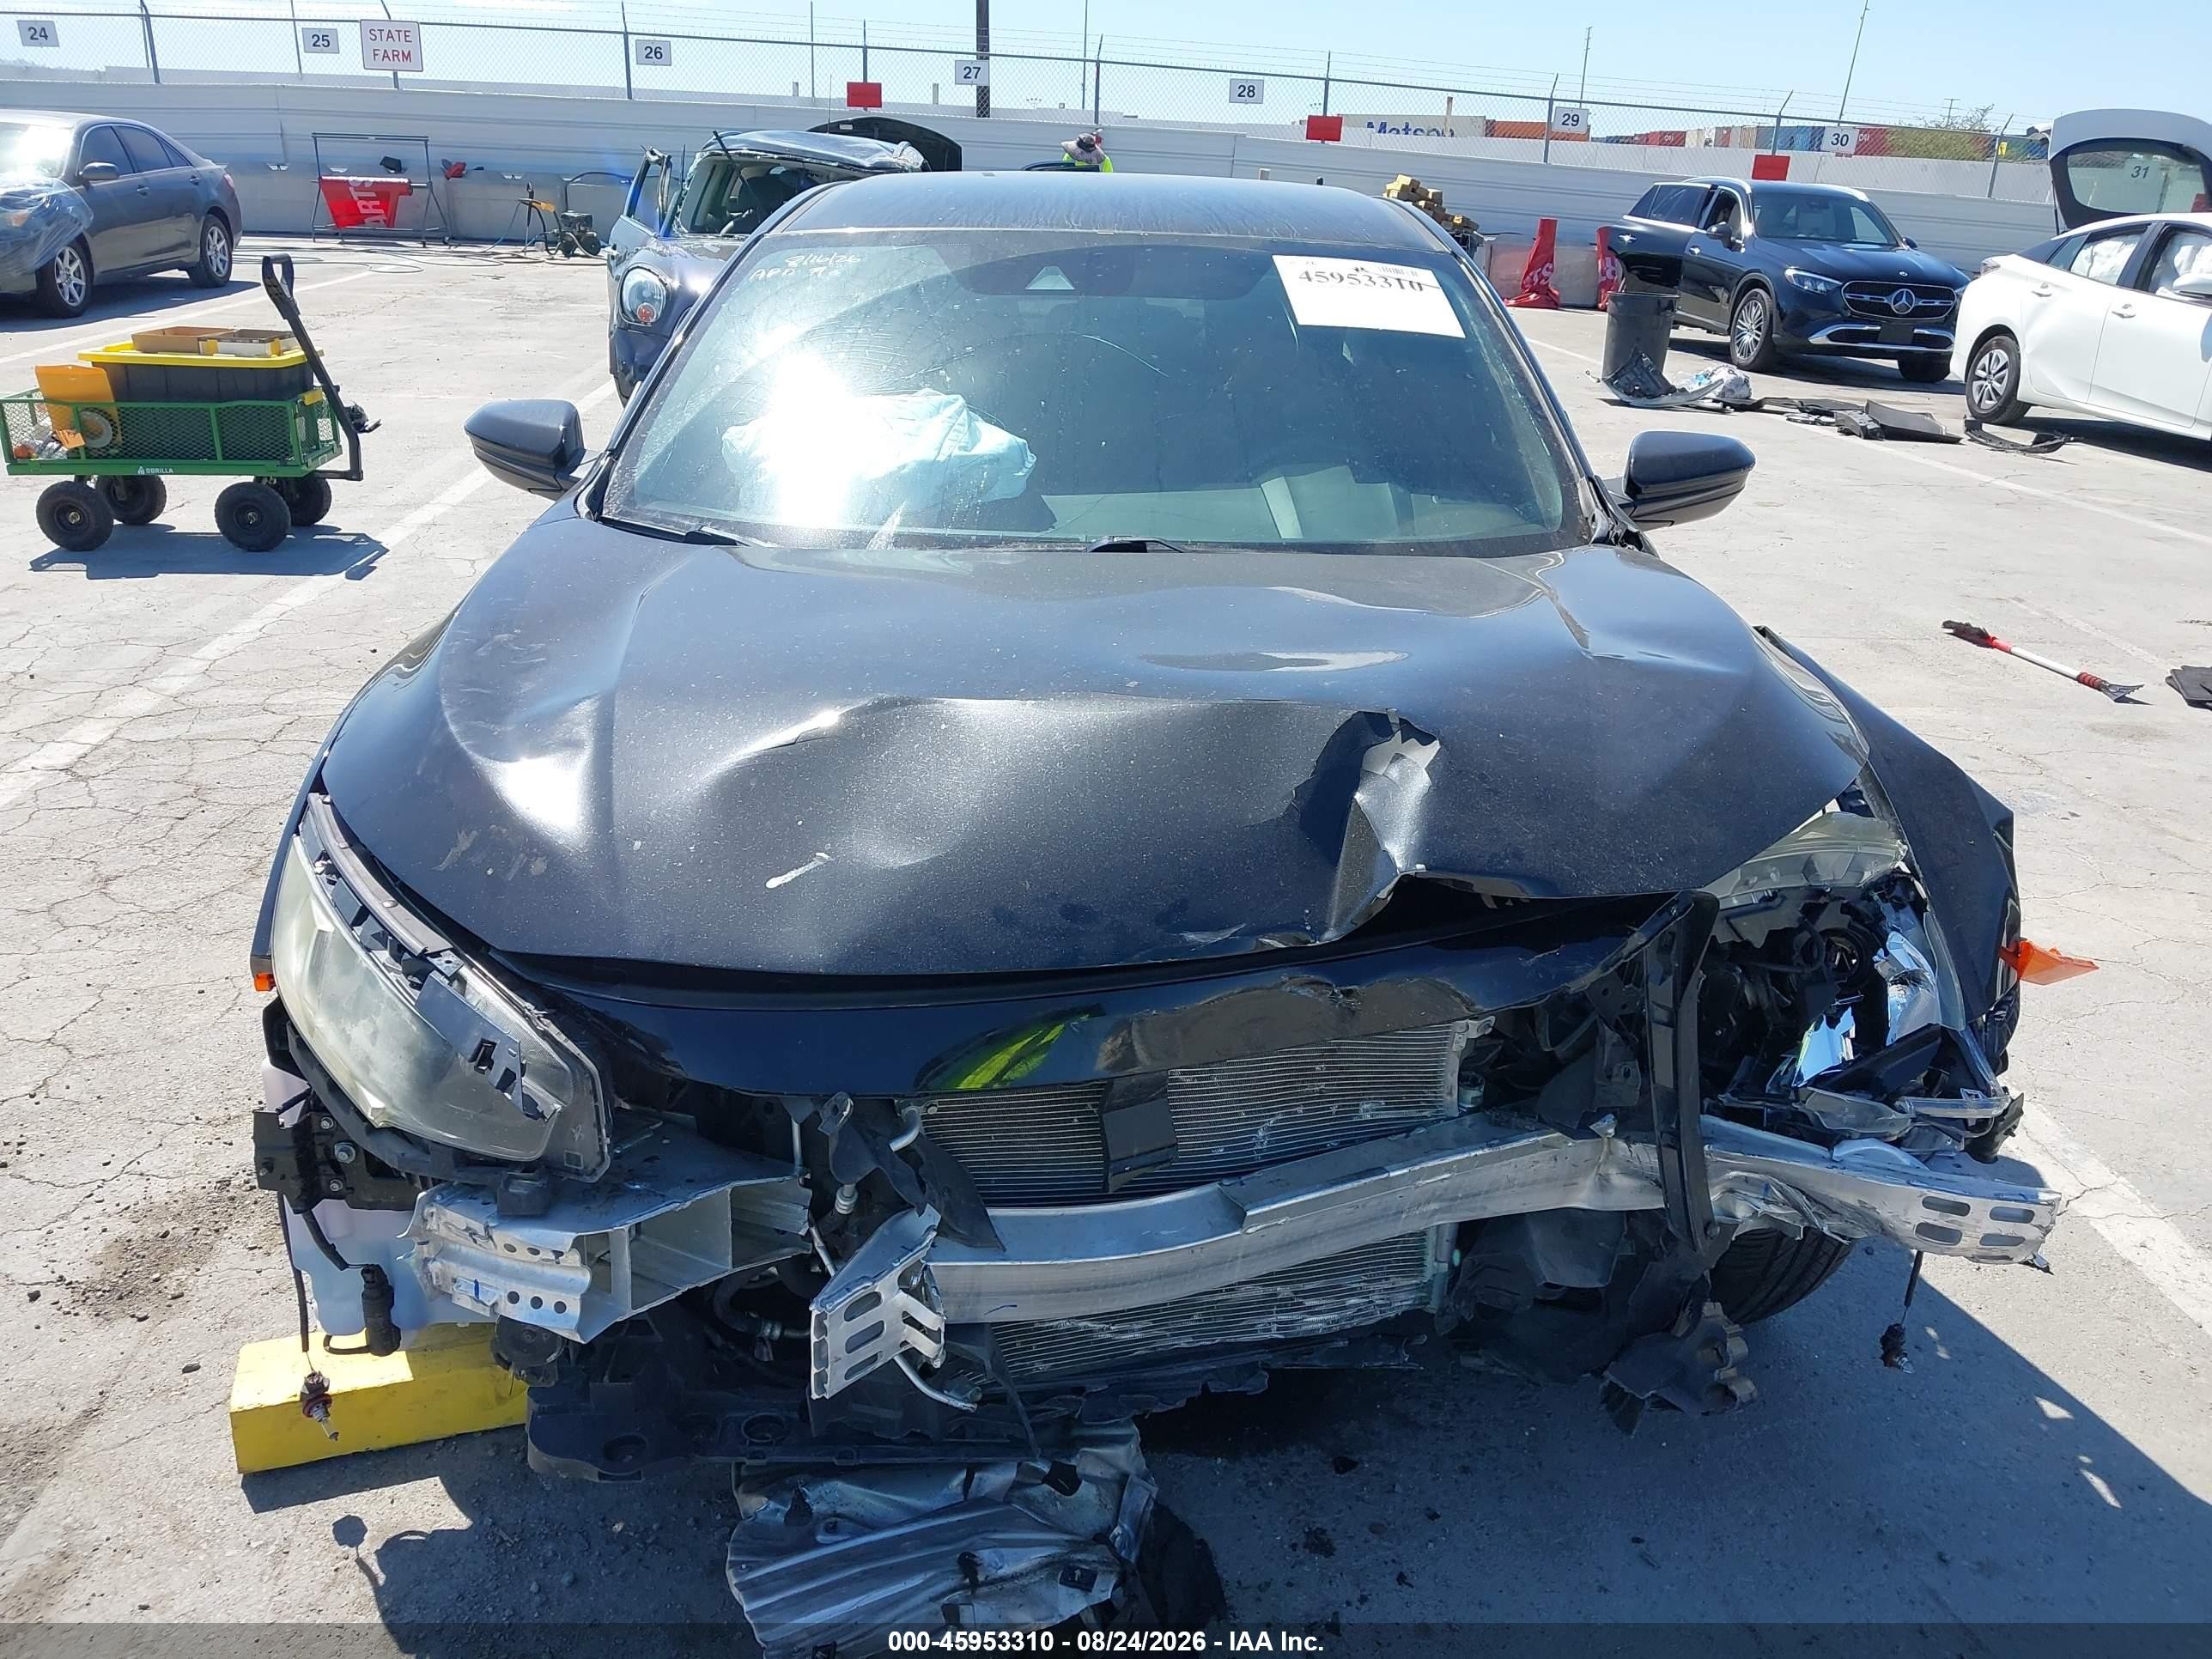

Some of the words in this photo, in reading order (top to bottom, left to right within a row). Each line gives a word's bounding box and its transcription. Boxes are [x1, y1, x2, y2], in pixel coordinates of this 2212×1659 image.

[27, 27, 49, 40] 24
[311, 34, 331, 48] 25
[368, 28, 413, 43] STATE
[373, 48, 415, 64] FARM
[644, 45, 663, 60] 26
[963, 65, 981, 79] 27
[1237, 84, 1255, 99] 28
[1560, 112, 1580, 127] 29
[1831, 132, 1850, 147] 30
[2130, 165, 2150, 179] 31
[1298, 269, 1425, 293] 45953310
